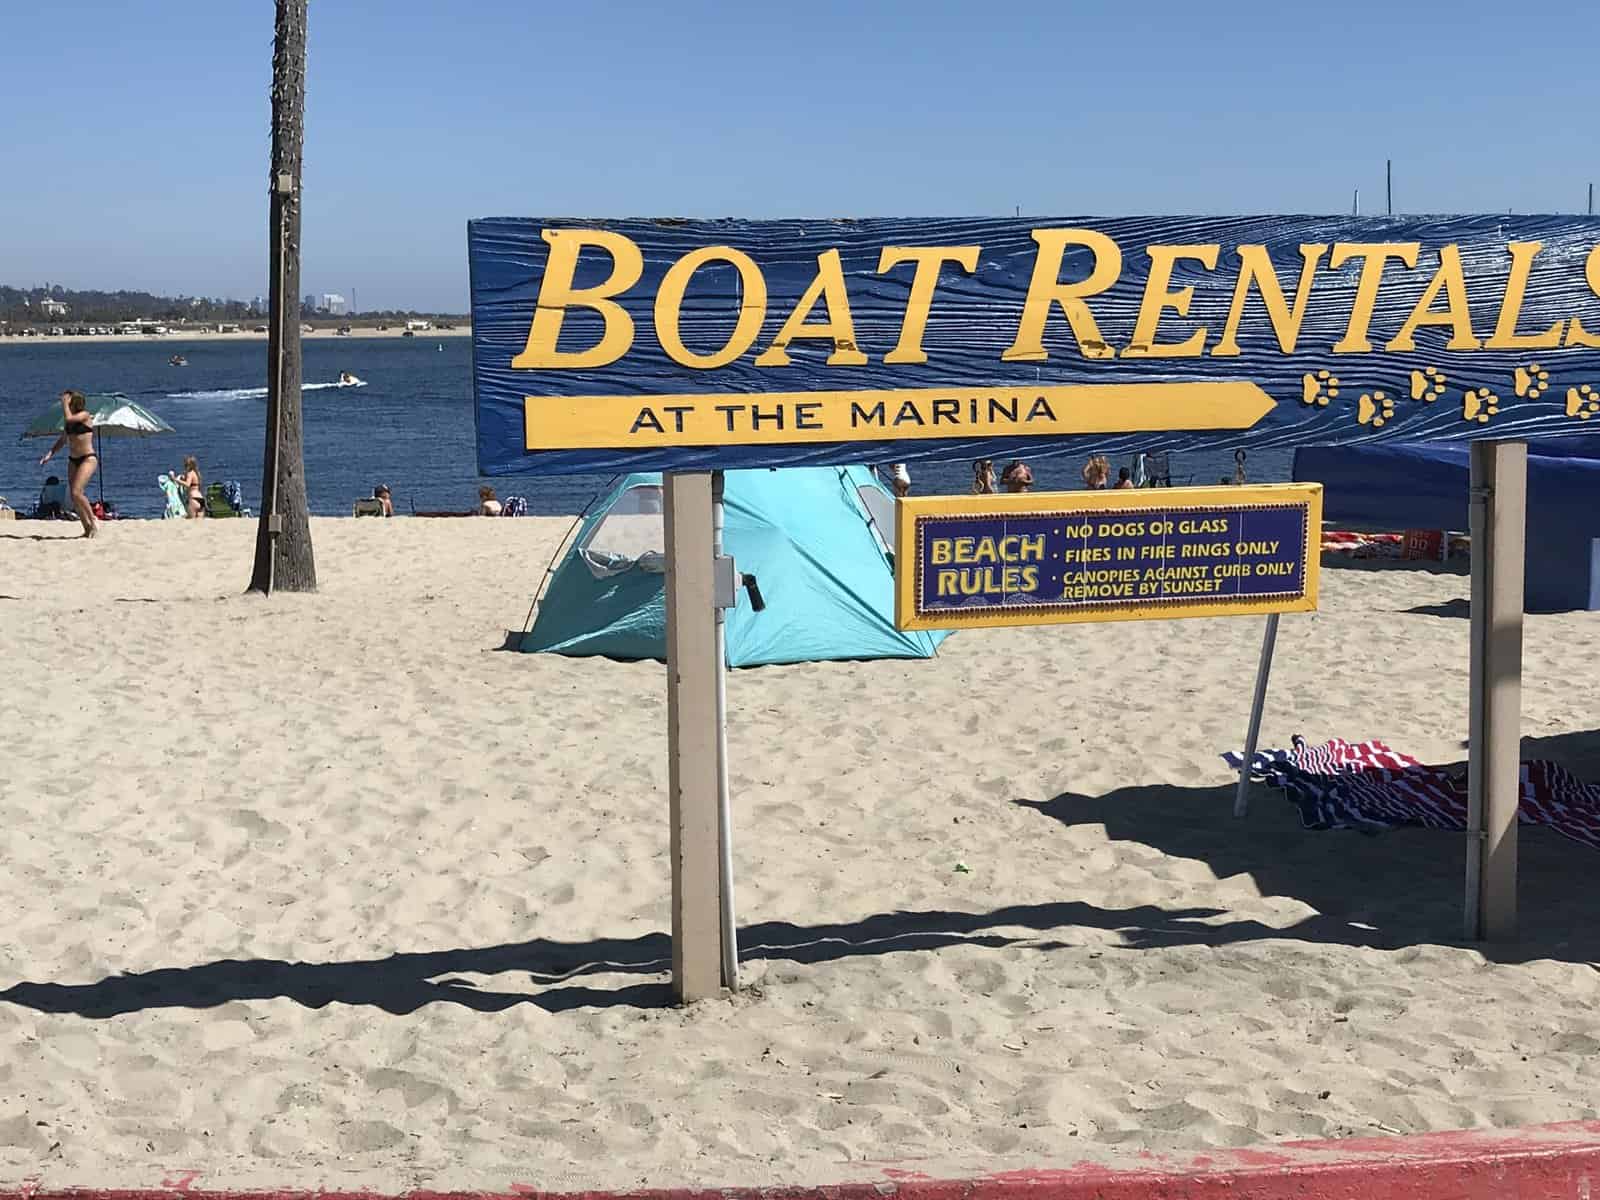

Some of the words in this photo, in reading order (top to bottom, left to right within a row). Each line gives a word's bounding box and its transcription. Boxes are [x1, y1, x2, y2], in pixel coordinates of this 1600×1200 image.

[511, 228, 981, 370] BOAT
[629, 406, 695, 434] AT
[715, 403, 824, 432] THE
[850, 396, 1057, 428] MARINA
[1066, 525, 1094, 538] NO
[1098, 522, 1146, 537] DOGS
[1149, 521, 1175, 535] OR
[1178, 519, 1228, 534] GLASS
[931, 533, 1046, 565] BEACH
[1065, 547, 1112, 563] FIRES
[1117, 547, 1136, 560] IN
[1140, 545, 1176, 560] FIRE
[1181, 542, 1231, 558] RINGS
[1235, 541, 1280, 556] ONLY
[937, 566, 1040, 596] RULES
[1063, 569, 1140, 584] CANOPIES
[1143, 565, 1208, 581] AGAINST
[1213, 563, 1252, 578] CURB
[1255, 562, 1295, 576] ONLY
[1063, 583, 1134, 599] REMOVE
[1139, 581, 1159, 595] BY
[1162, 579, 1223, 594] SUNSET
